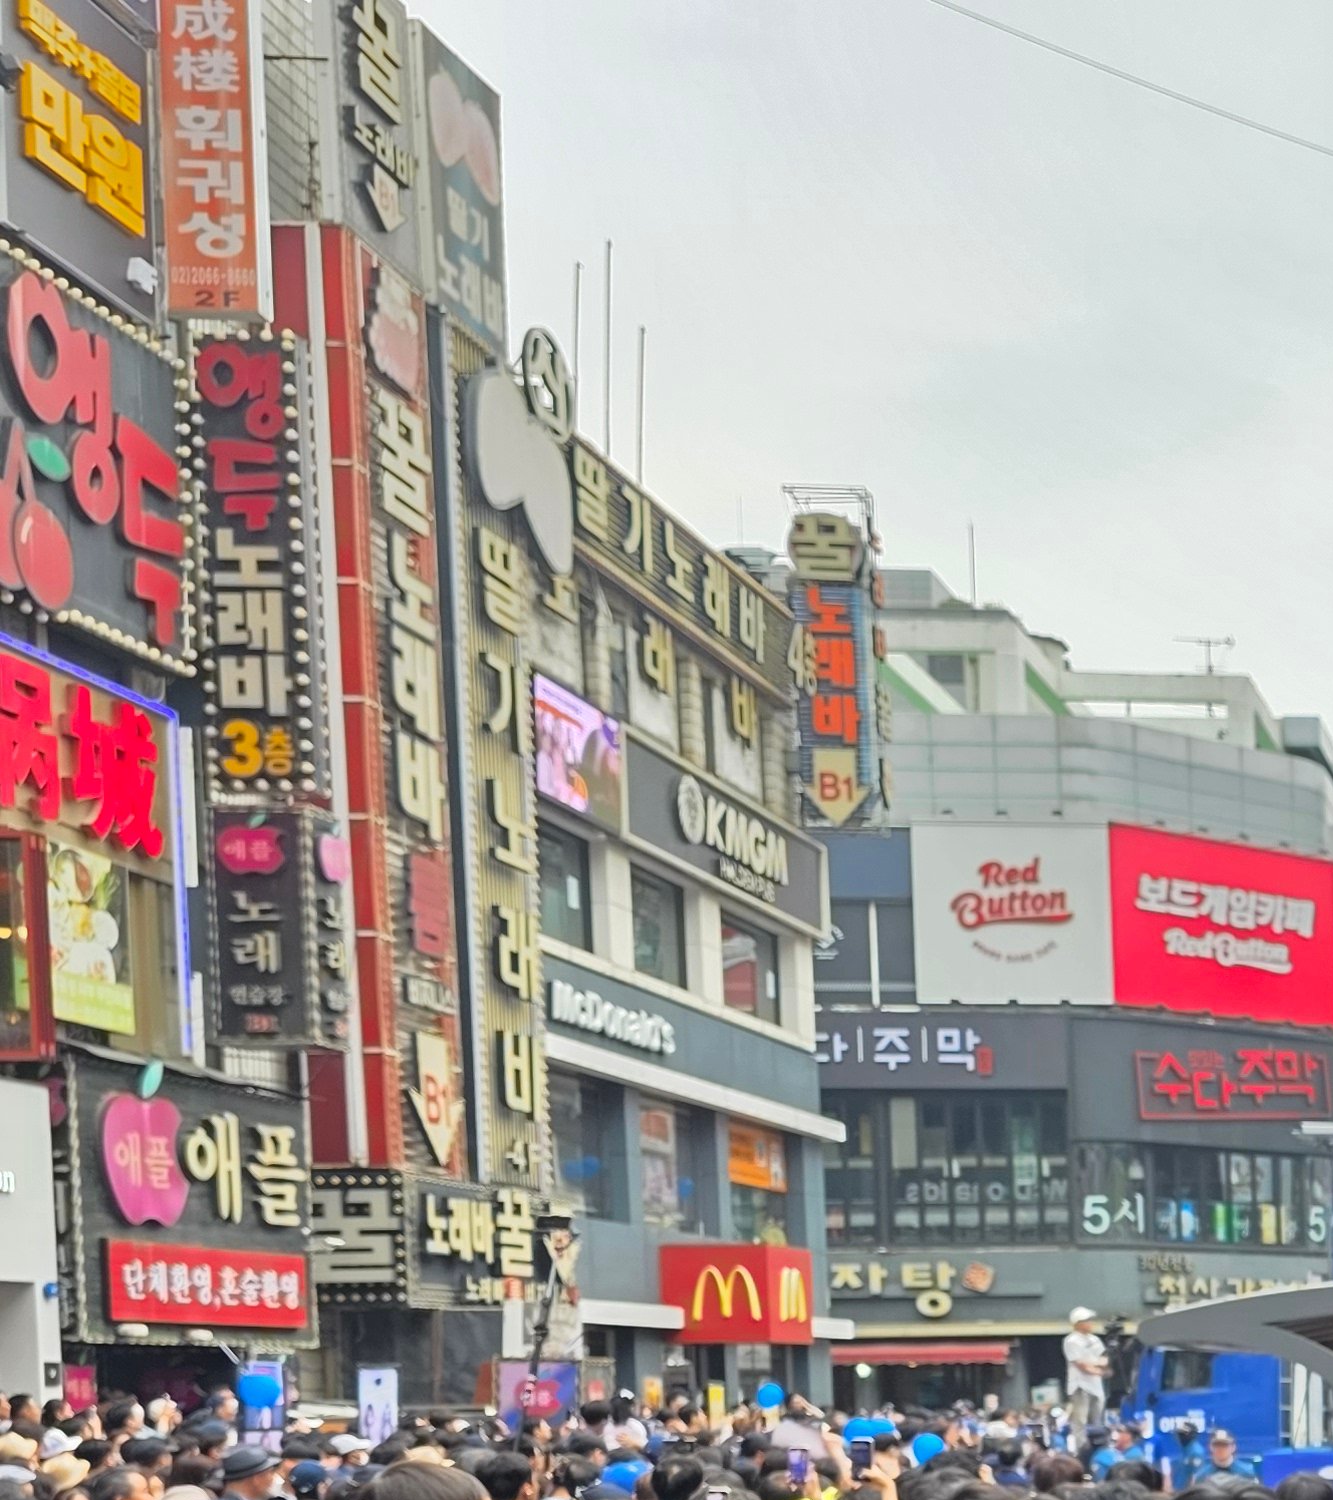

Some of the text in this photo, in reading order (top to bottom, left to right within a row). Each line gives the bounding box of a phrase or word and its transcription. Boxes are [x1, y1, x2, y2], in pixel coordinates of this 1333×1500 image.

[20, 62, 146, 240] 만원
[174, 105, 246, 259] 훠궈성
[193, 290, 240, 308] 2F
[806, 585, 861, 745] 노래바
[222, 717, 295, 778] 3층
[819, 772, 855, 803] B1
[978, 857, 1041, 889] Red
[951, 890, 1074, 930] Button
[1134, 872, 1316, 939] 보드게임카페
[1163, 927, 1214, 958] Red
[550, 978, 677, 1056] McDonald's
[1153, 1049, 1320, 1109] 수다주막
[113, 1130, 175, 1192] 애플
[186, 1111, 308, 1228] 애플
